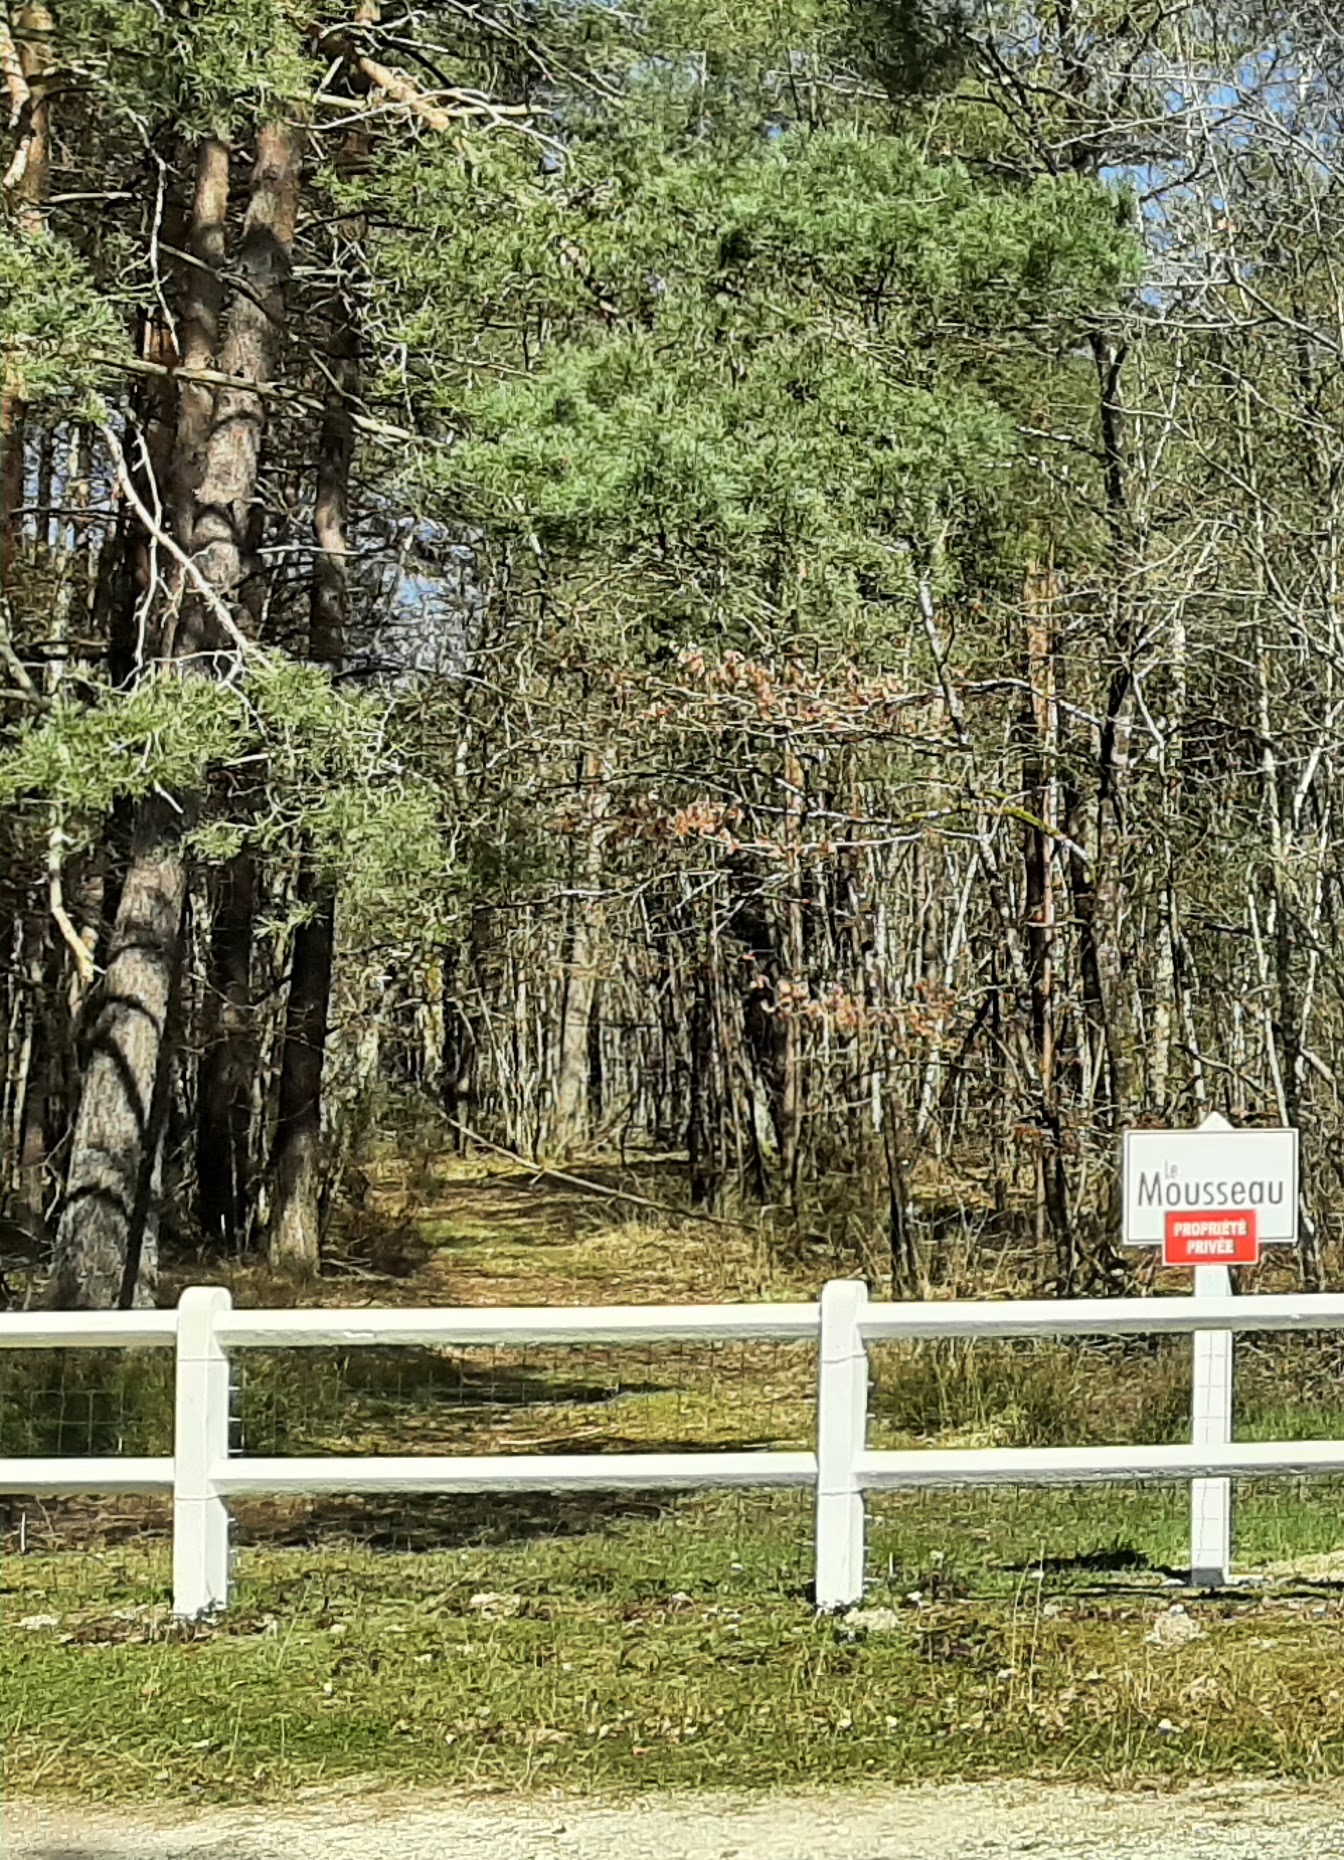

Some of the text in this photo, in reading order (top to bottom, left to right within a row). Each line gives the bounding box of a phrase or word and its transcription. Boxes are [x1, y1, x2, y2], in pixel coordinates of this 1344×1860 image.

[1165, 1160, 1178, 1179] Le
[1138, 1171, 1284, 1207] Mousseau
[1173, 1218, 1248, 1237] PROPRIÉTÉ
[1186, 1239, 1235, 1255] PRIVÉE
